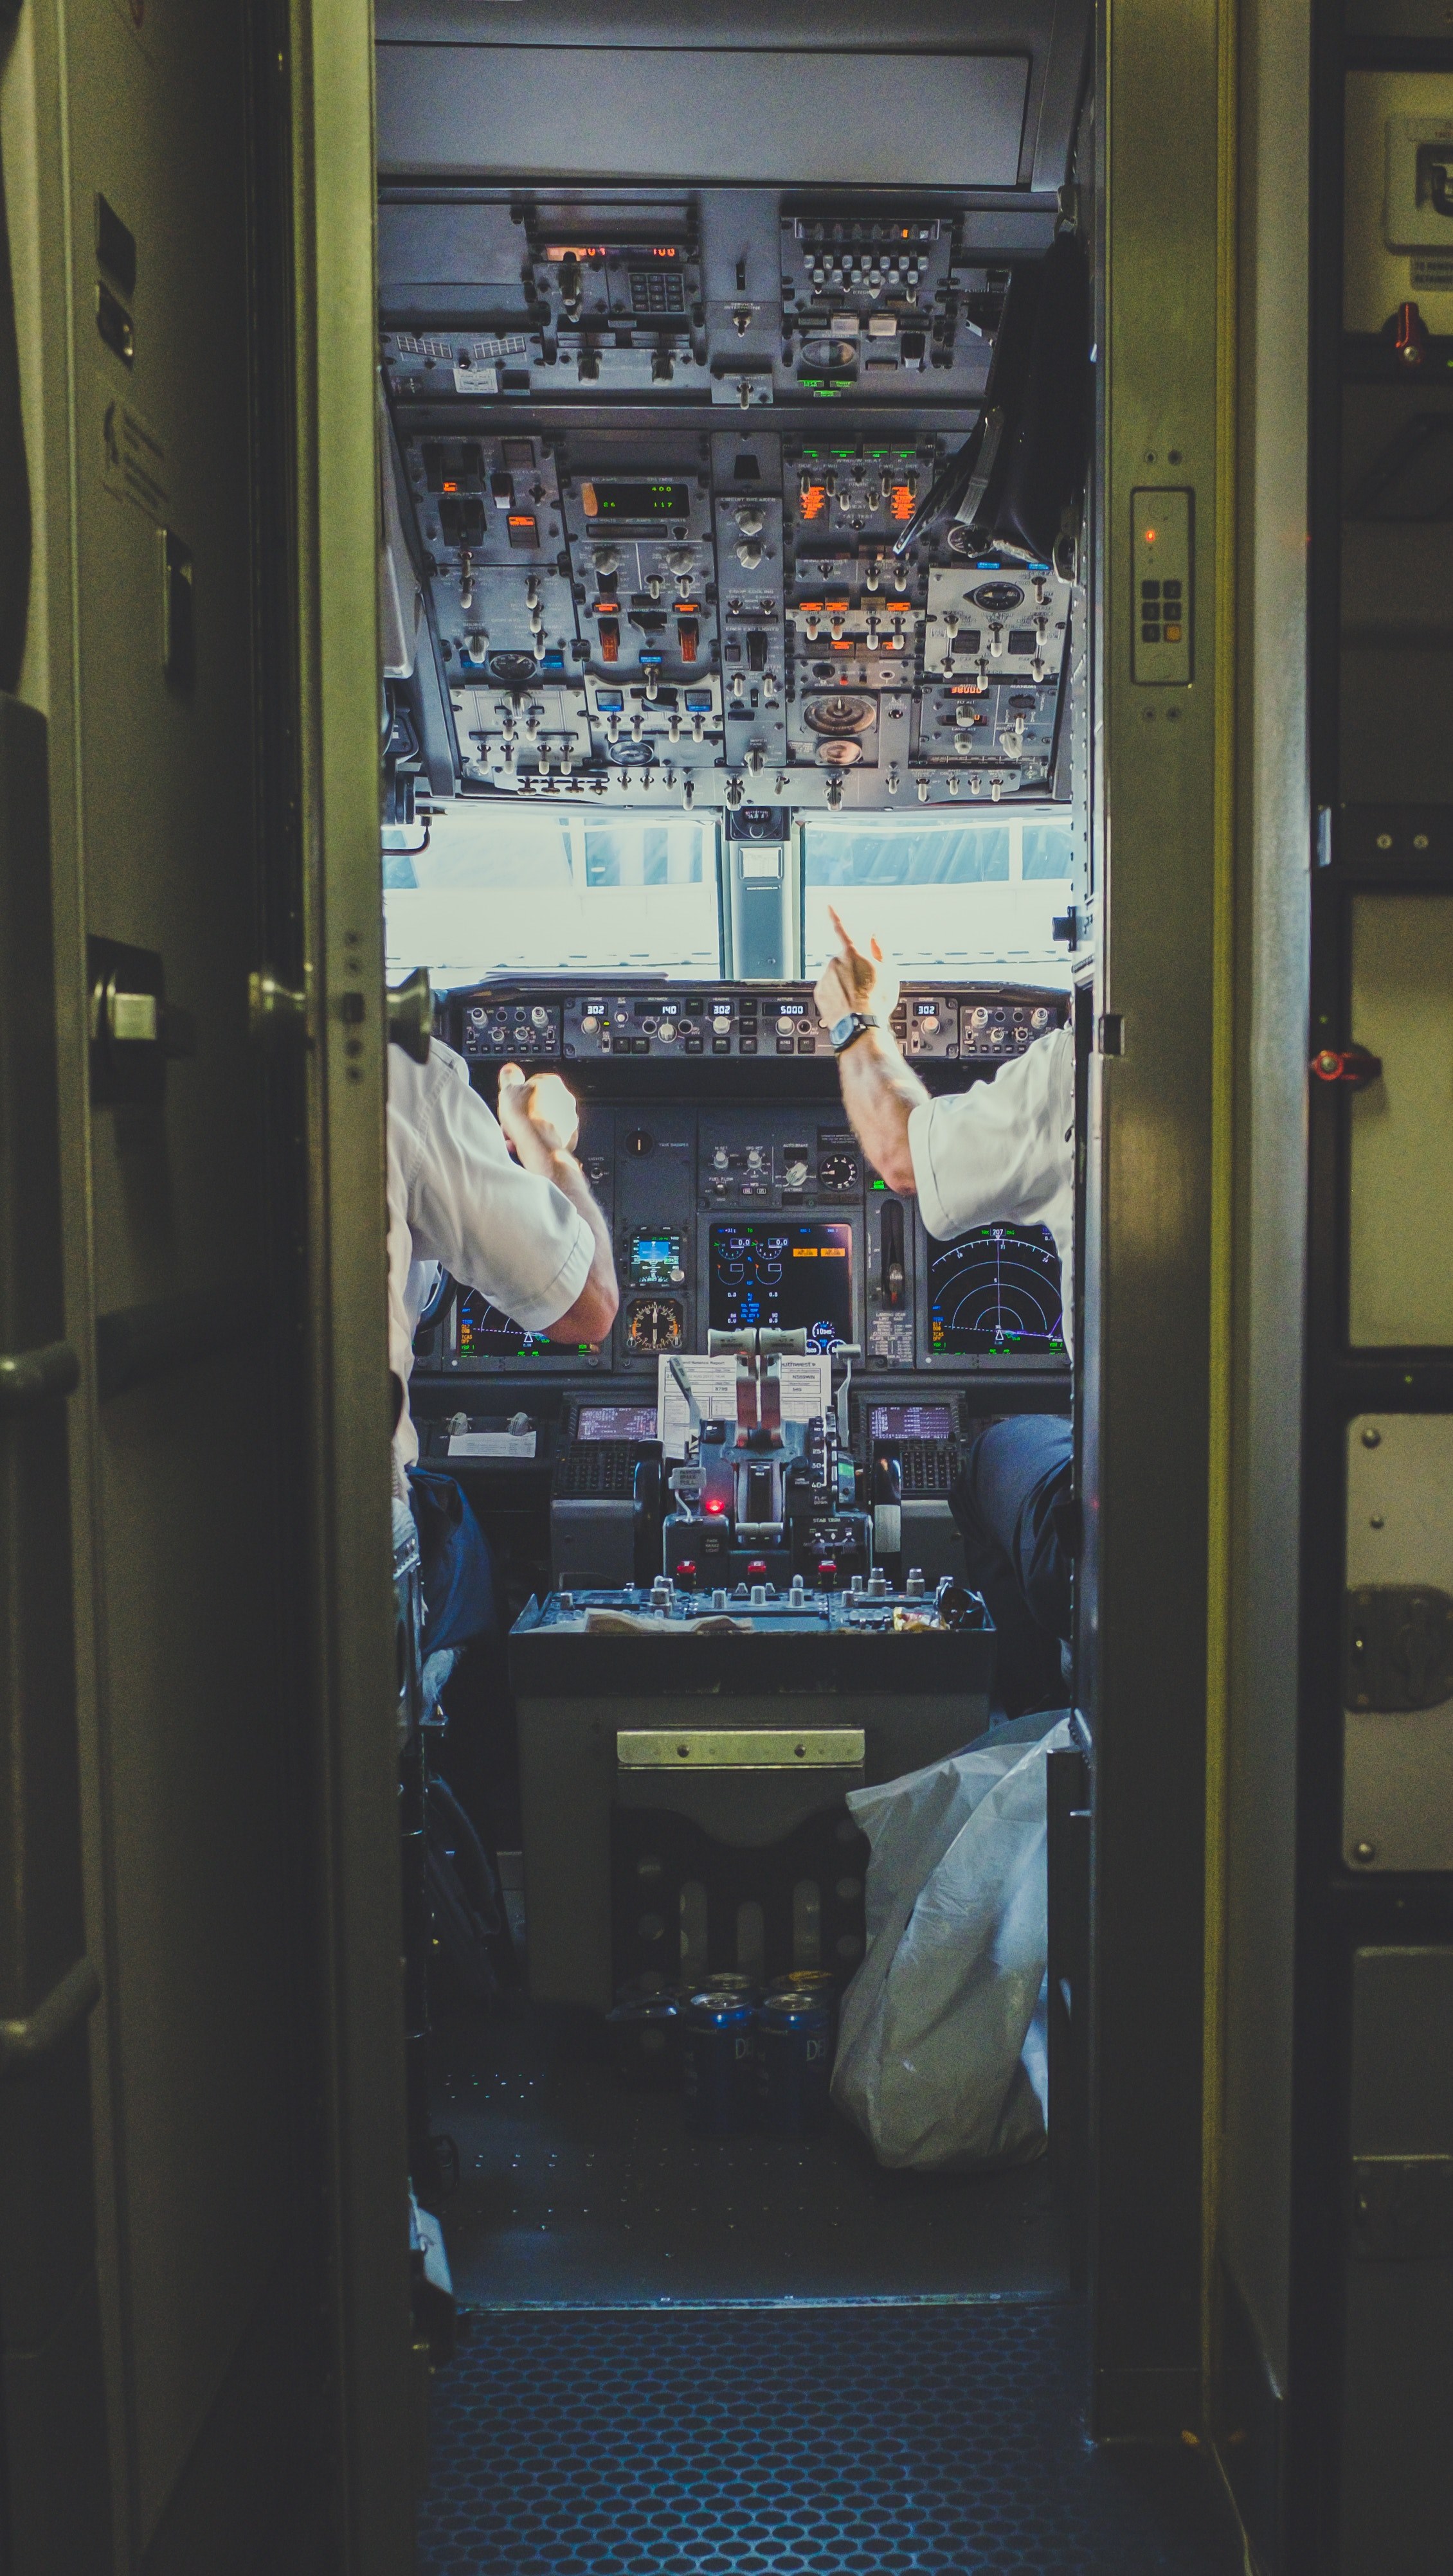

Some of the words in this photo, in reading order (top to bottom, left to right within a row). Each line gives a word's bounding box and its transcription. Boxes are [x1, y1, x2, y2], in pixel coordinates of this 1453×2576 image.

[588, 1005, 604, 1014] 302
[662, 1005, 677, 1015] 140
[714, 1005, 730, 1014] 302
[781, 1005, 804, 1014] 5000
[918, 1005, 935, 1014] 302
